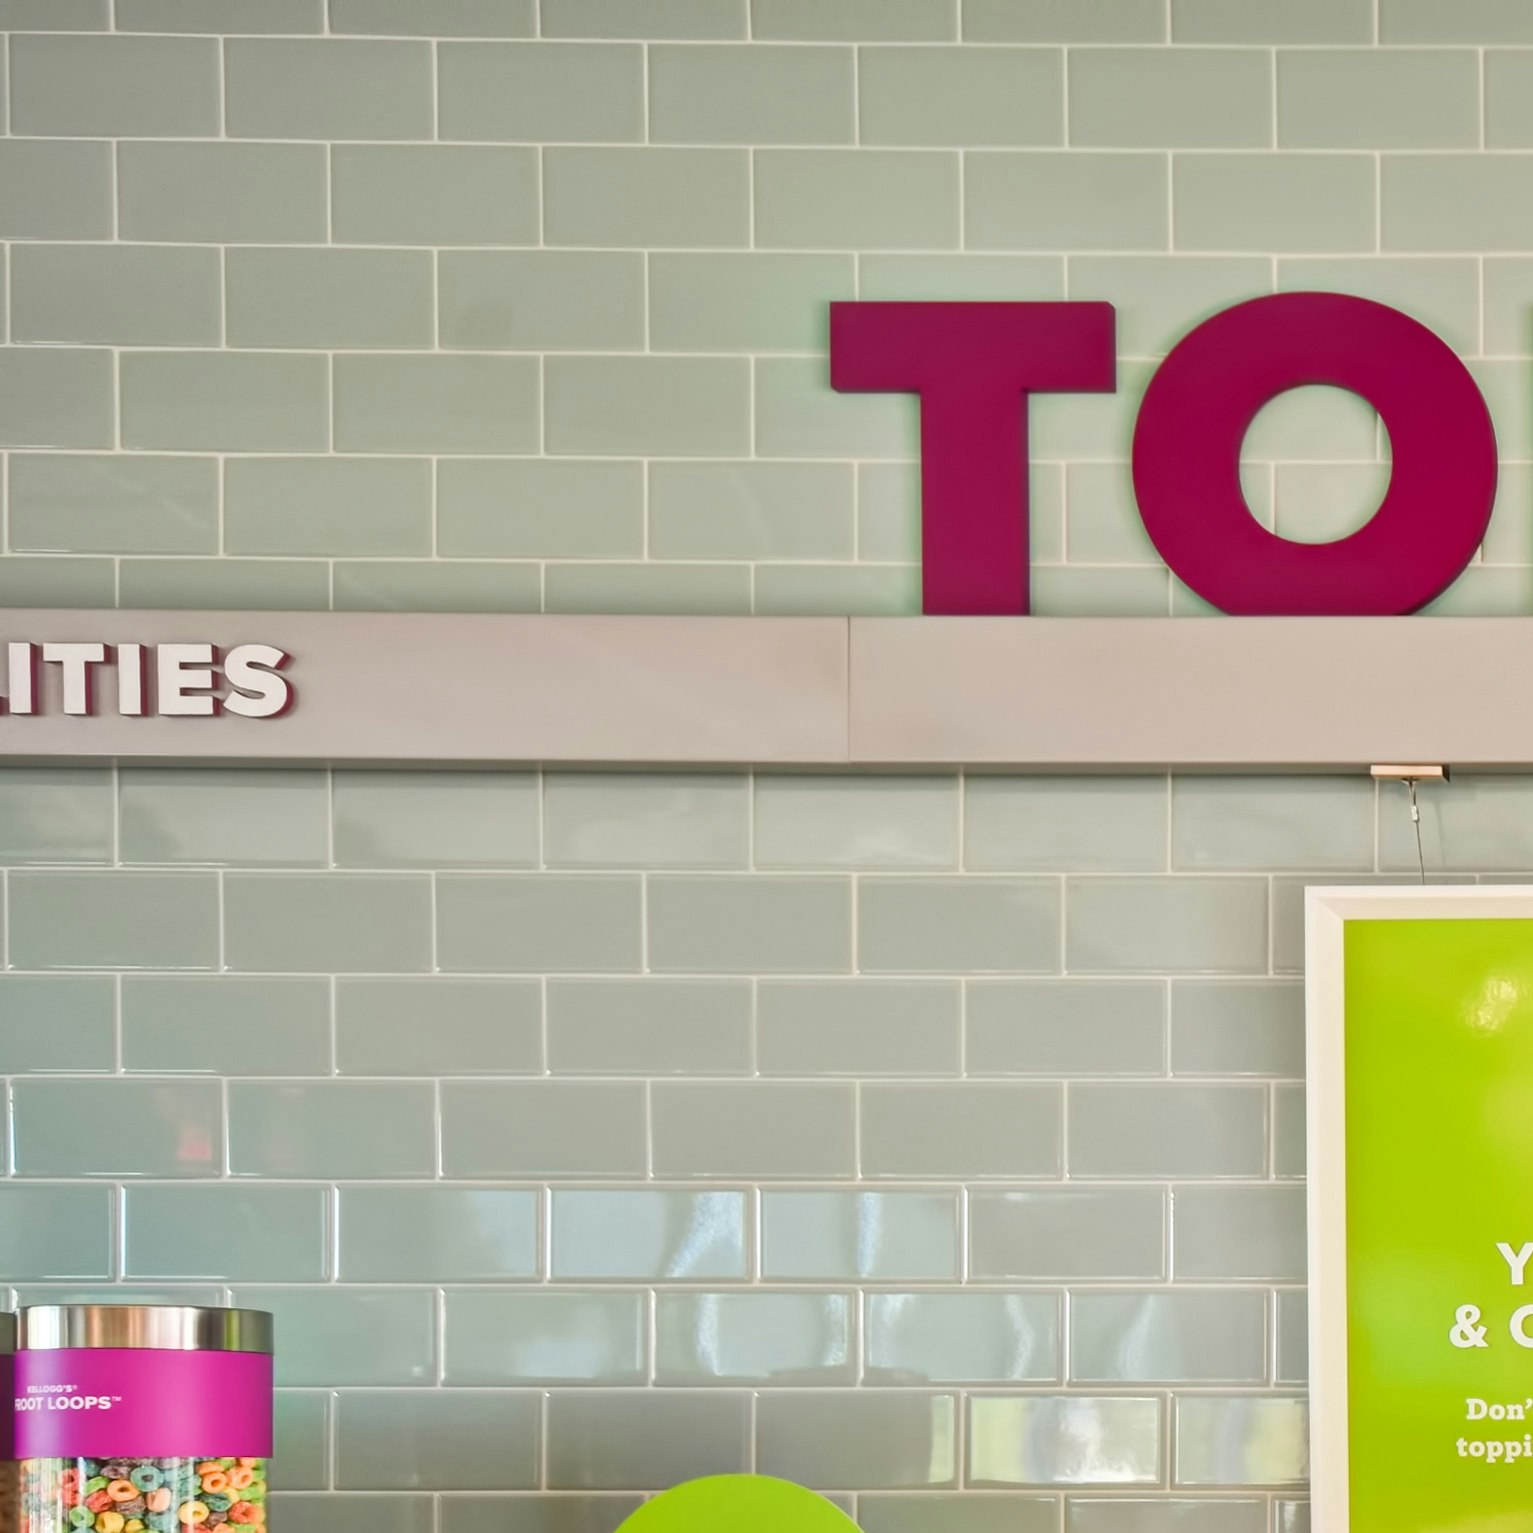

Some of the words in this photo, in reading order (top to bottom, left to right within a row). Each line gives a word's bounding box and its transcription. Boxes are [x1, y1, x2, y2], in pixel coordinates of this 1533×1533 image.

[8, 643, 290, 717] ITIES
[1449, 1304, 1488, 1348] &
[14, 1397, 44, 1411] ROOT
